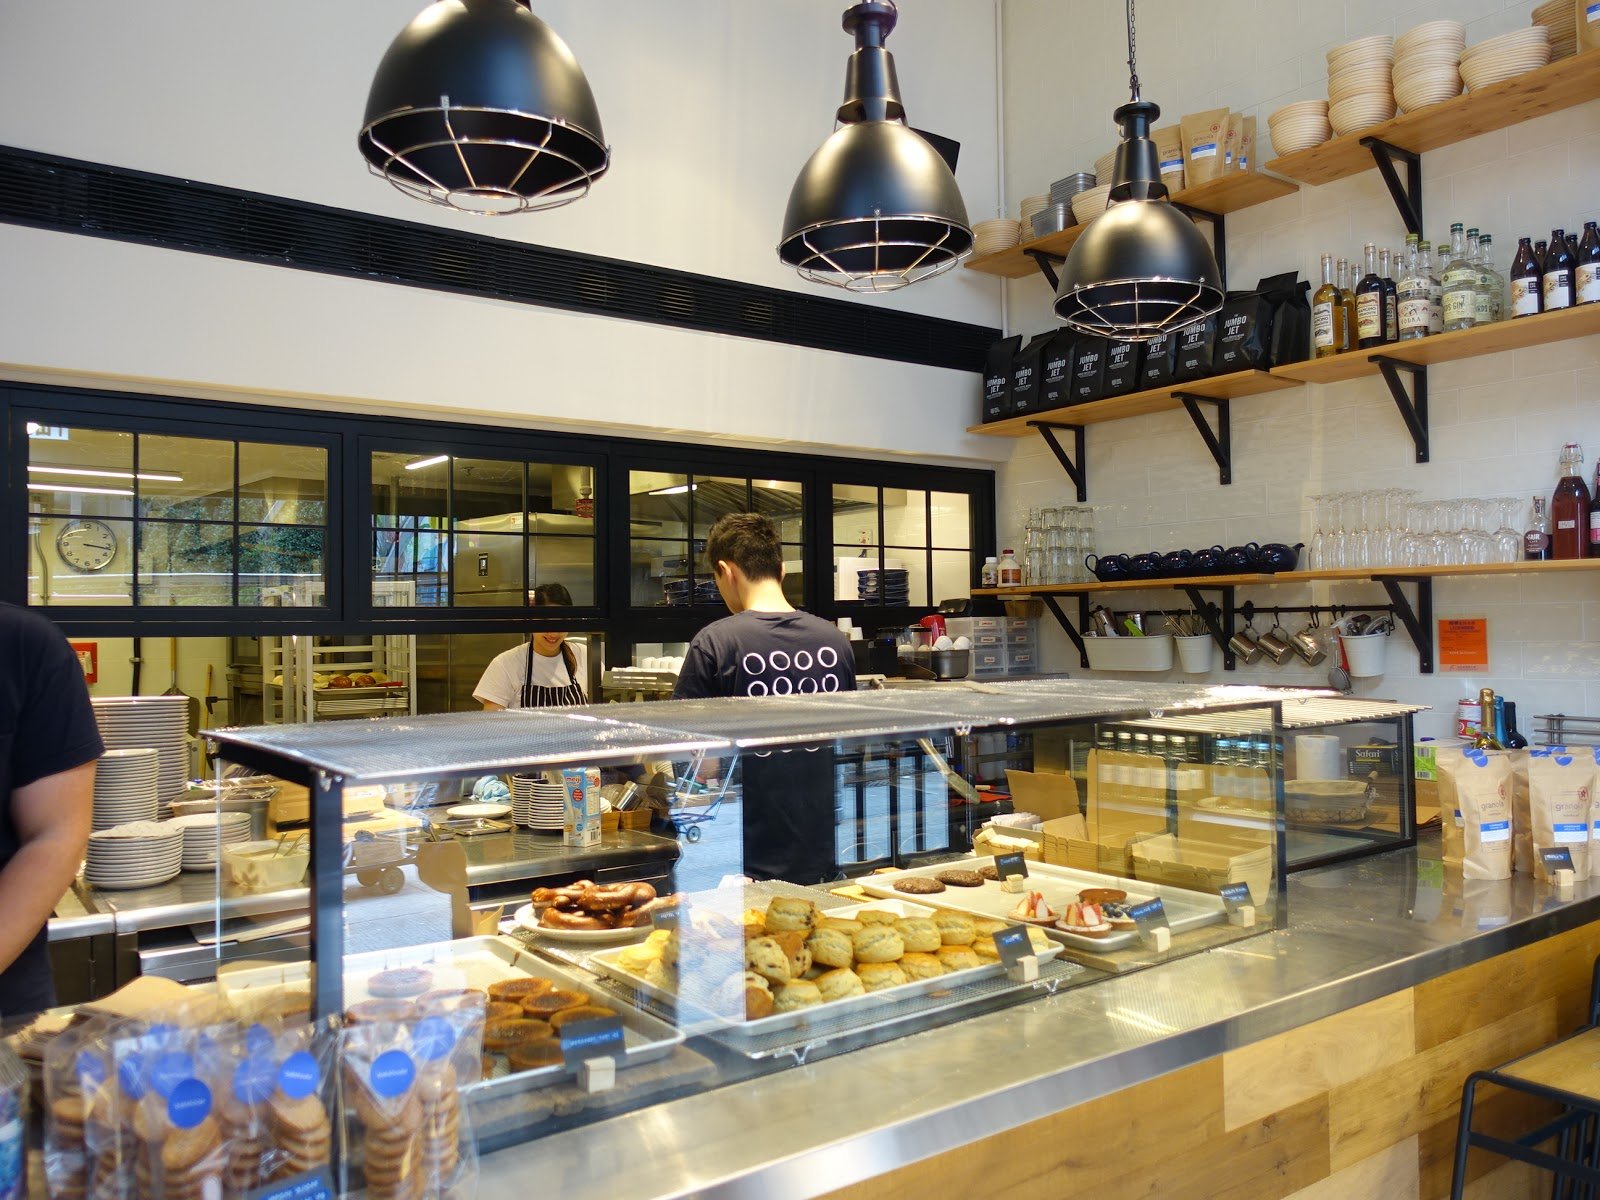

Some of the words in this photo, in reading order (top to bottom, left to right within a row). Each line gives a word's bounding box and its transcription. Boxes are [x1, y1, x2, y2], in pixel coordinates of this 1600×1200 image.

[1224, 316, 1247, 329] JUMBO
[1227, 325, 1240, 336] JET
[1187, 333, 1199, 344] JET
[1111, 345, 1130, 356] JUMBO
[1150, 344, 1161, 353] JET
[1079, 354, 1099, 365] JUMBO
[1114, 354, 1124, 363] JET
[1047, 360, 1066, 371] JUMBO
[1083, 363, 1093, 372] JET
[1015, 368, 1032, 379] JUMBO
[1051, 368, 1061, 377] JET
[987, 378, 1006, 387] JUMBO
[1019, 377, 1027, 386] JET
[1355, 749, 1381, 758] Safari
[1481, 800, 1505, 811] granola
